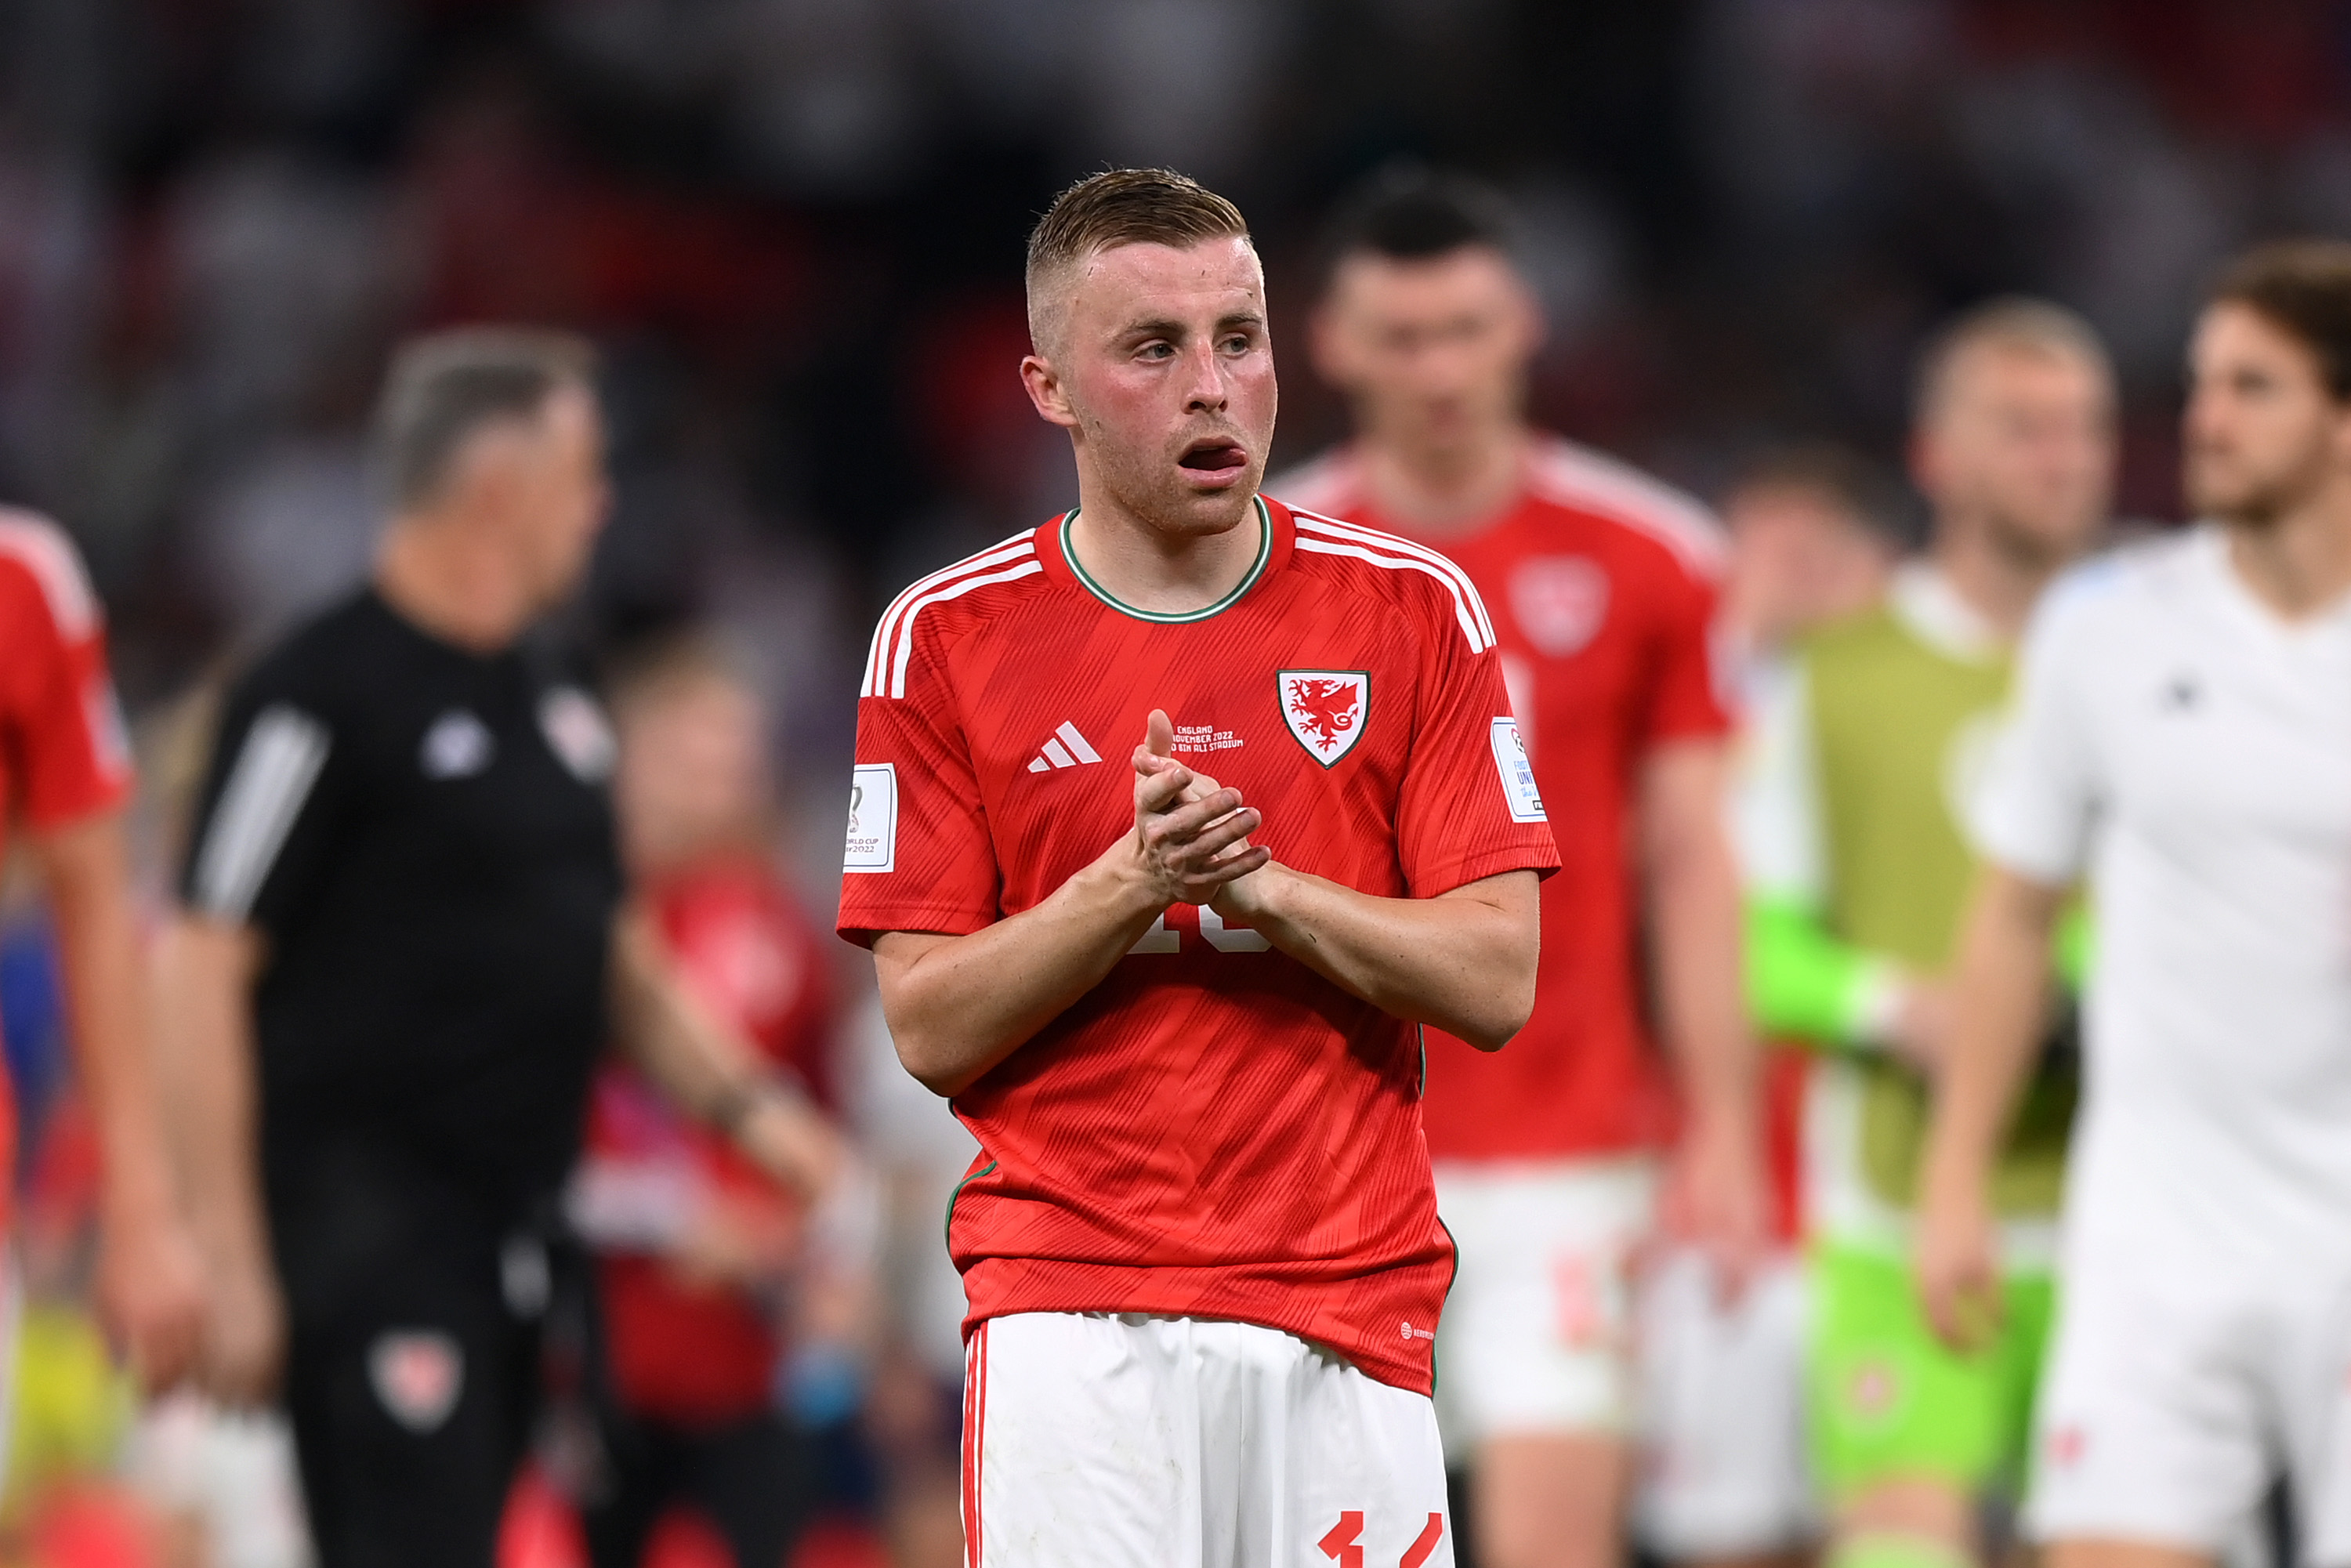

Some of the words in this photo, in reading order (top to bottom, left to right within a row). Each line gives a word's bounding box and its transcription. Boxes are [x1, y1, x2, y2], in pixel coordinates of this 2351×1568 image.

[1177, 726, 1213, 735] ENGLAND
[1212, 731, 1233, 742] 2022
[1178, 744, 1192, 752] BIN
[1194, 744, 1207, 752] ALI
[1209, 739, 1244, 751] STADIUM
[1516, 771, 1533, 785] UNI
